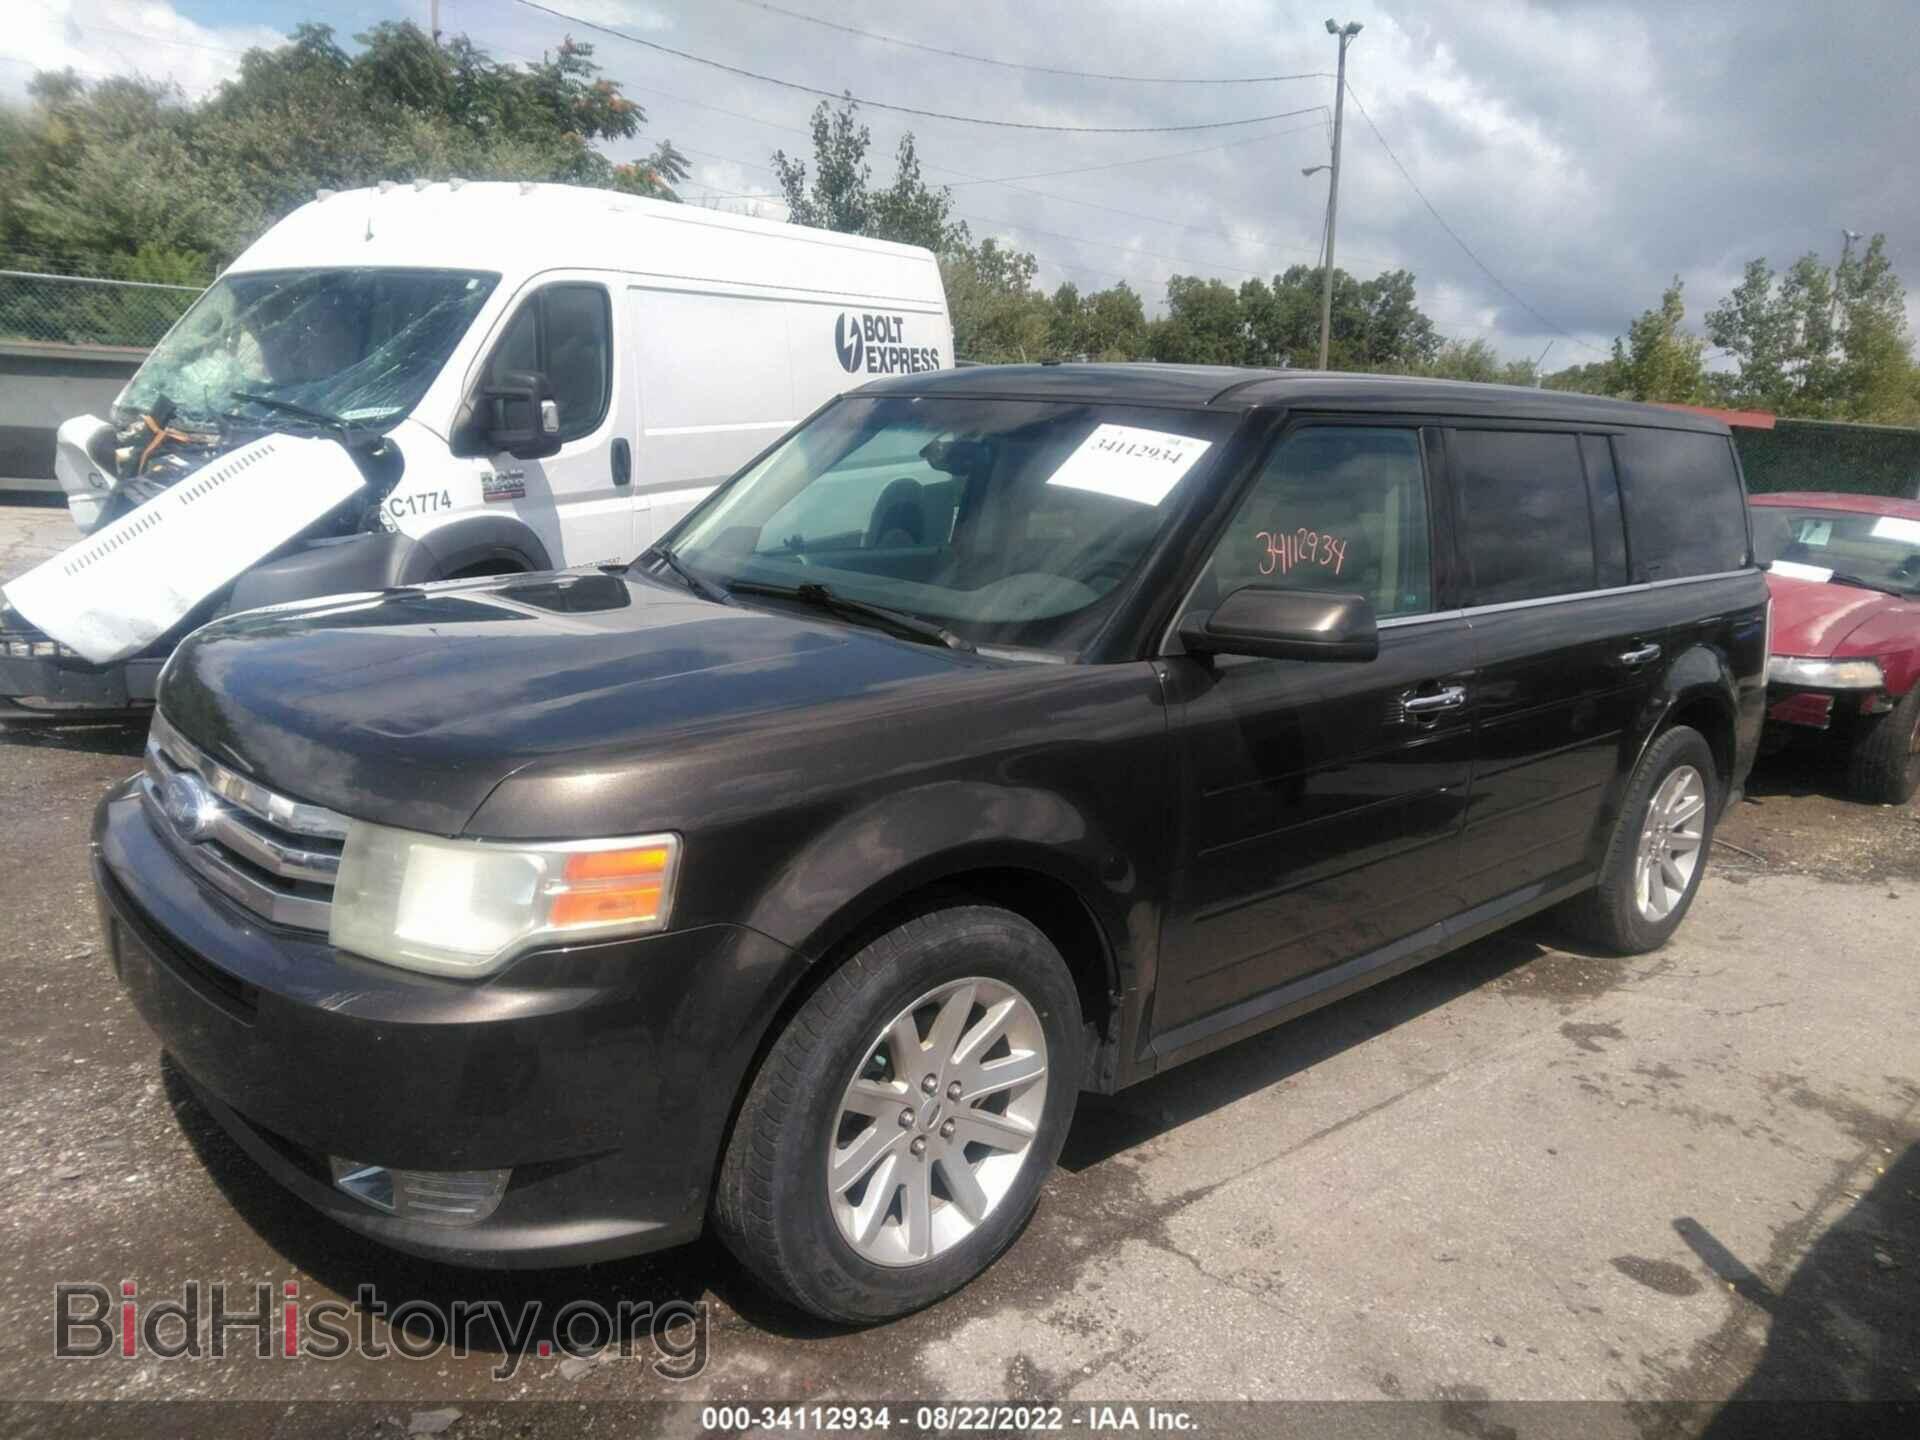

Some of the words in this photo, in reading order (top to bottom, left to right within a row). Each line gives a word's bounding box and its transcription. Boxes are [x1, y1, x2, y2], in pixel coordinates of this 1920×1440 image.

[862, 314, 903, 343] BOLT
[865, 346, 940, 374] EXPRESS
[1095, 438, 1183, 464] 34112934
[389, 489, 452, 518] C1774
[1256, 527, 1347, 575] 34112934
